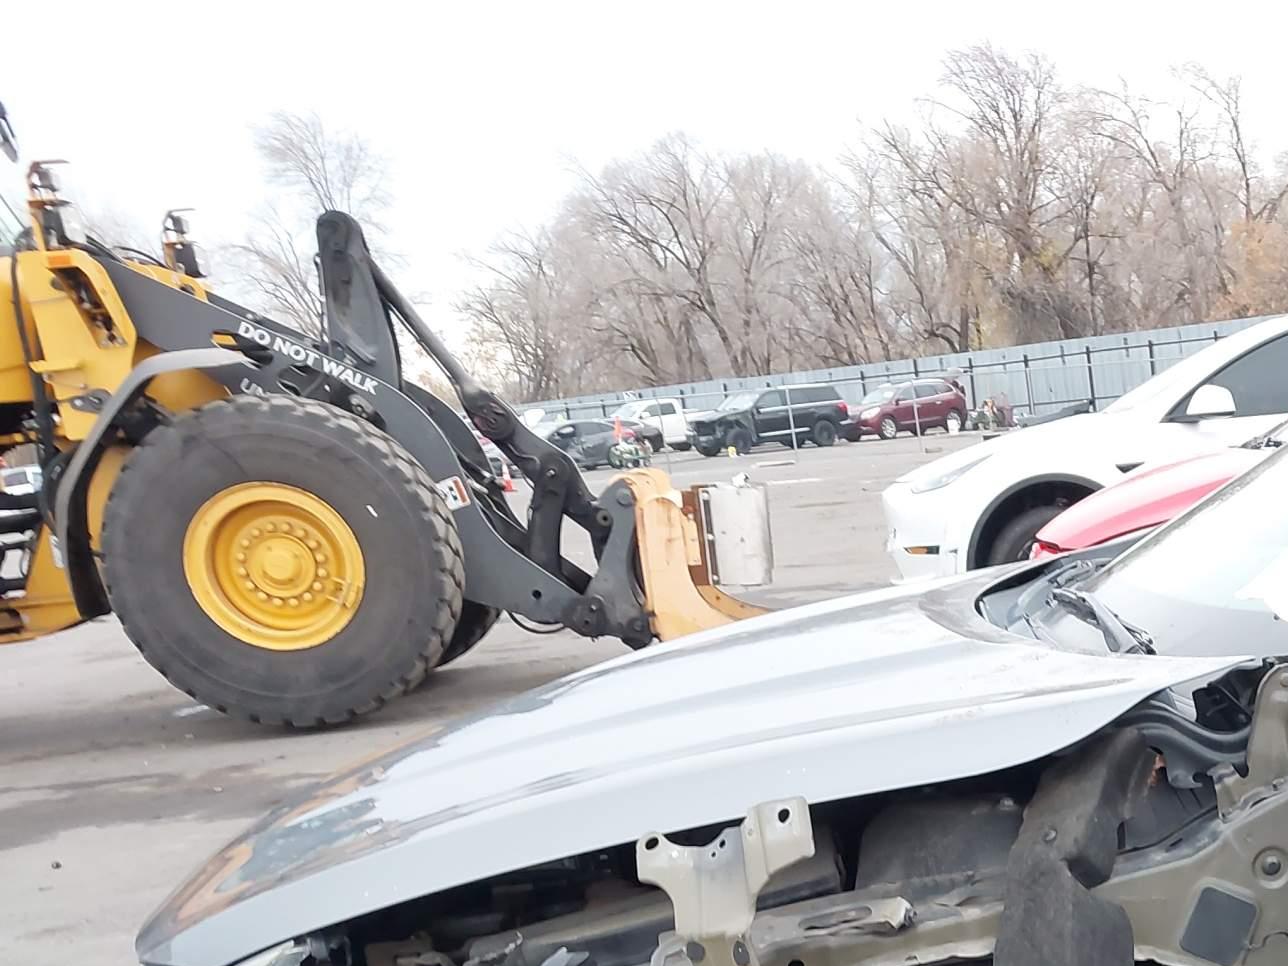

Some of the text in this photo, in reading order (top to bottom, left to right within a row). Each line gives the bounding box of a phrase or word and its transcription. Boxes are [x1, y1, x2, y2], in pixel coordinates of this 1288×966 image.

[237, 321, 379, 396] DO NOT WALK
